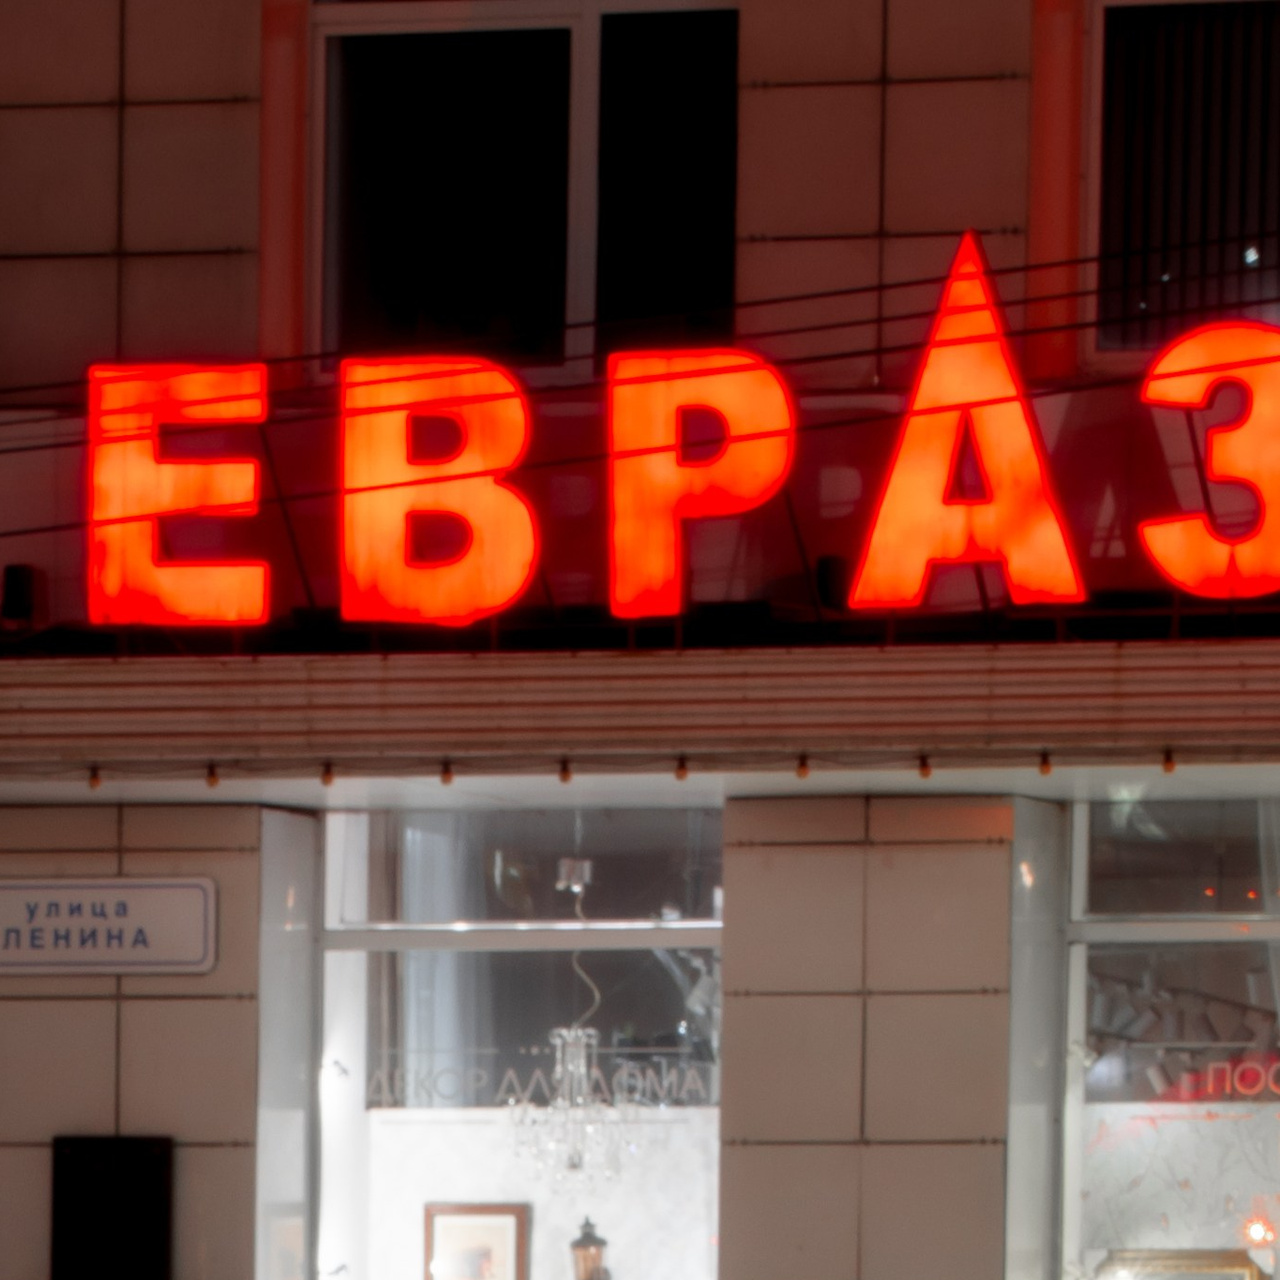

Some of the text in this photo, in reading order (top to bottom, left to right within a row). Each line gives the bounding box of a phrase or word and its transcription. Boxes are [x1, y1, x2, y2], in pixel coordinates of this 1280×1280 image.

[87, 230, 1280, 625] ЕВРАЗ
[26, 901, 129, 922] улица
[3, 928, 150, 950] ЛЕНИНА
[581, 1067, 706, 1103] ДОМА
